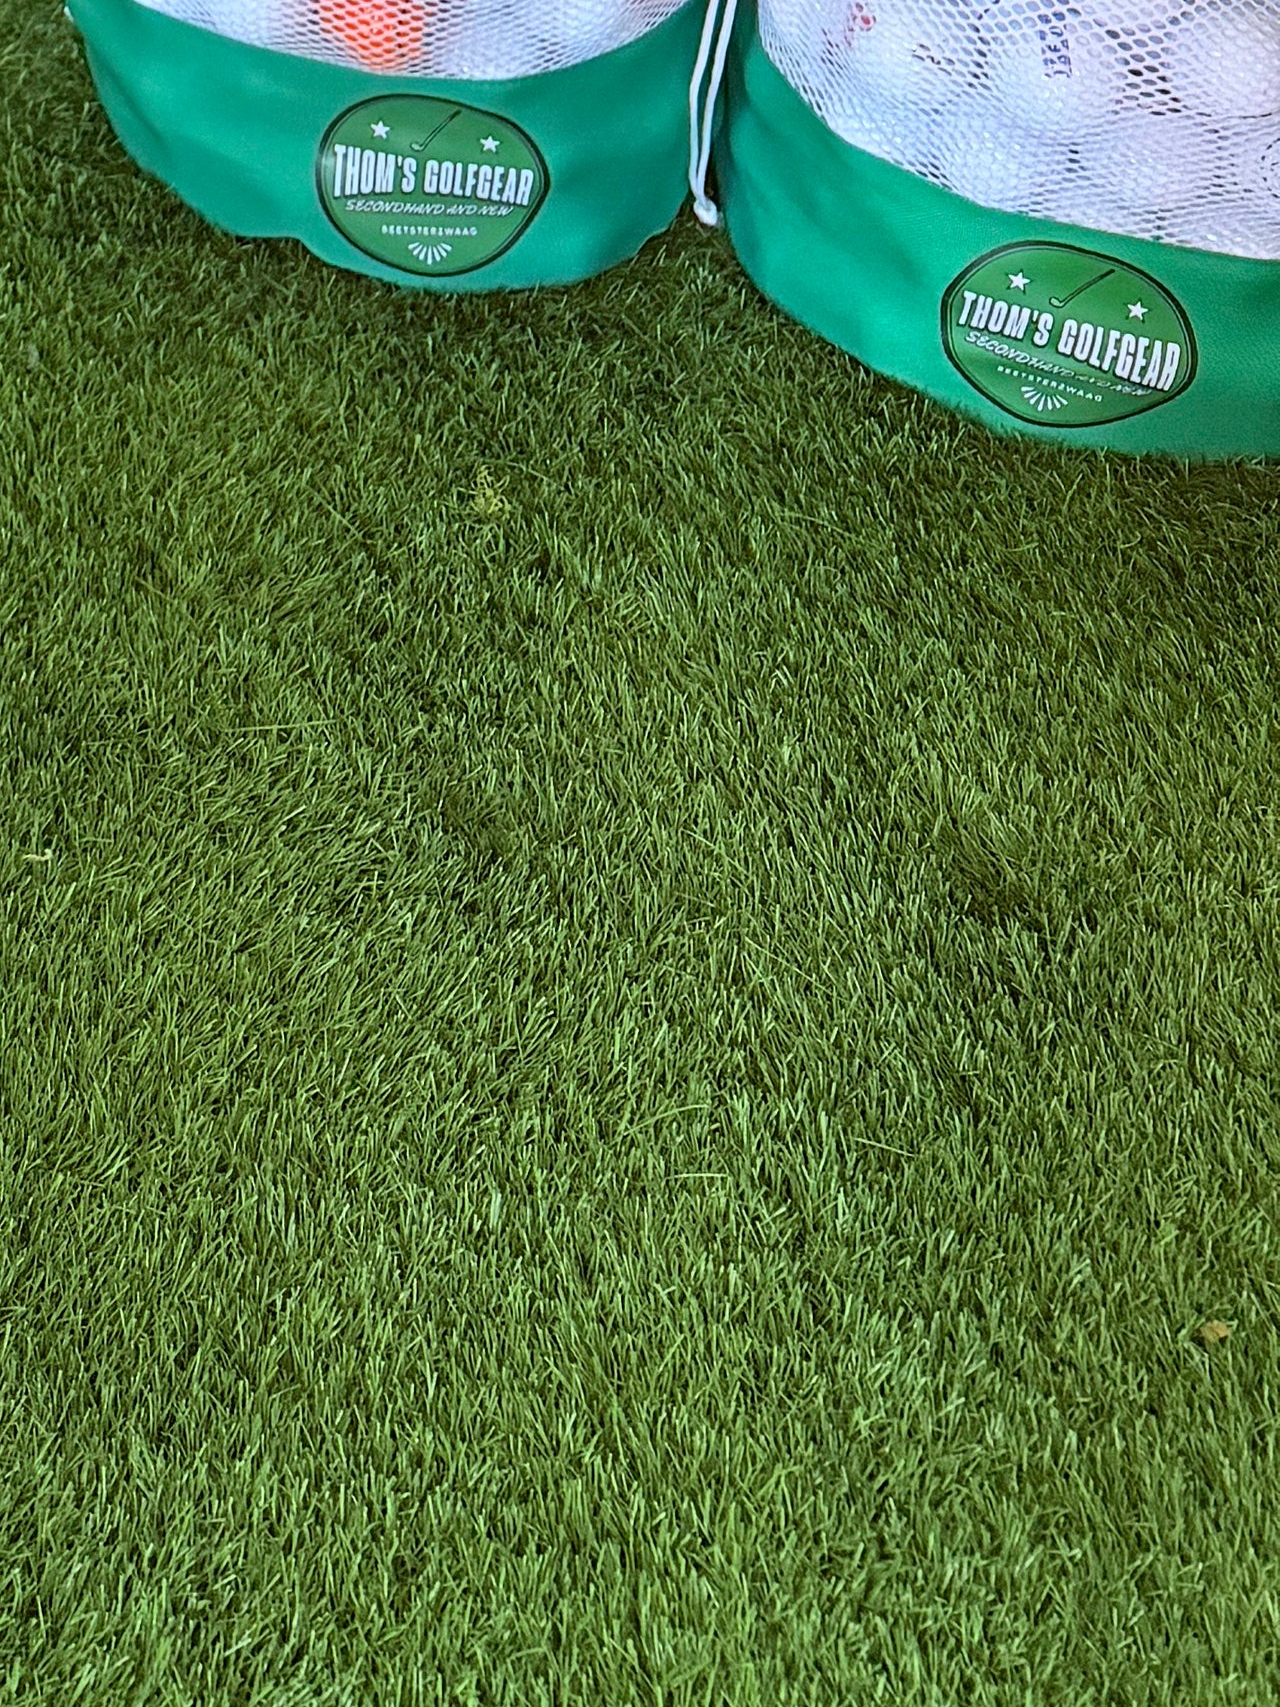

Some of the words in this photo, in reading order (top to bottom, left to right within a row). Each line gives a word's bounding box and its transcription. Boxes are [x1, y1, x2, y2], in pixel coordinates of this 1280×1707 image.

[333, 143, 418, 198] THOM'S
[423, 159, 535, 206] GOLFGEAR
[446, 203, 477, 216] AND
[956, 290, 1055, 347] THOM'S
[1056, 318, 1182, 392] GOLFGEAR
